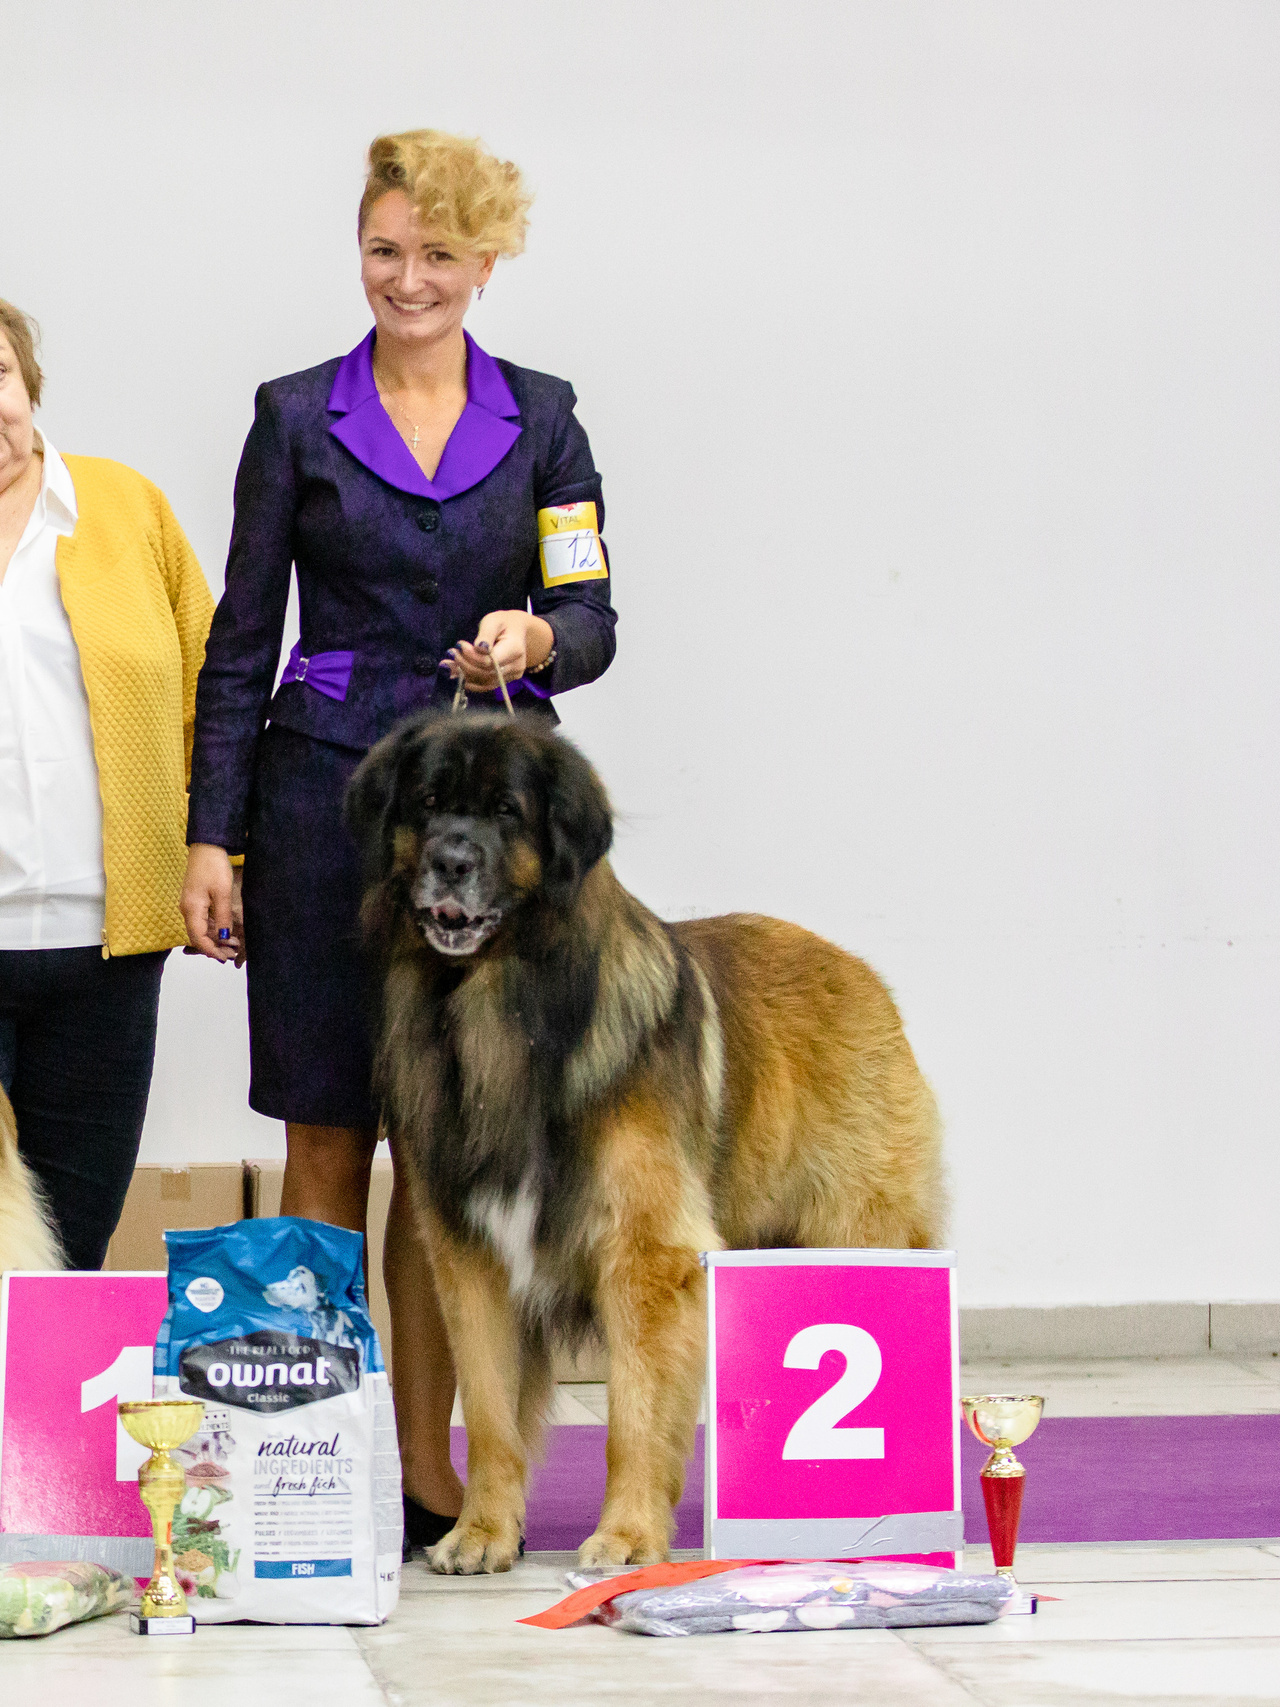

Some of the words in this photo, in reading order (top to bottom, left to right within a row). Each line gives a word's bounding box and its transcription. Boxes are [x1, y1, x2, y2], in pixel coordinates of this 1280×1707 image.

[550, 515, 581, 529] VITAL
[568, 531, 597, 569] 12
[207, 1356, 331, 1387] ownat
[782, 1323, 885, 1460] 2
[81, 1346, 153, 1481] 1
[257, 1432, 341, 1458] natural
[254, 1458, 353, 1475] INGREDIENTS
[273, 1476, 307, 1497] fresh
[308, 1476, 336, 1497] fish
[291, 1563, 315, 1575] FISH
